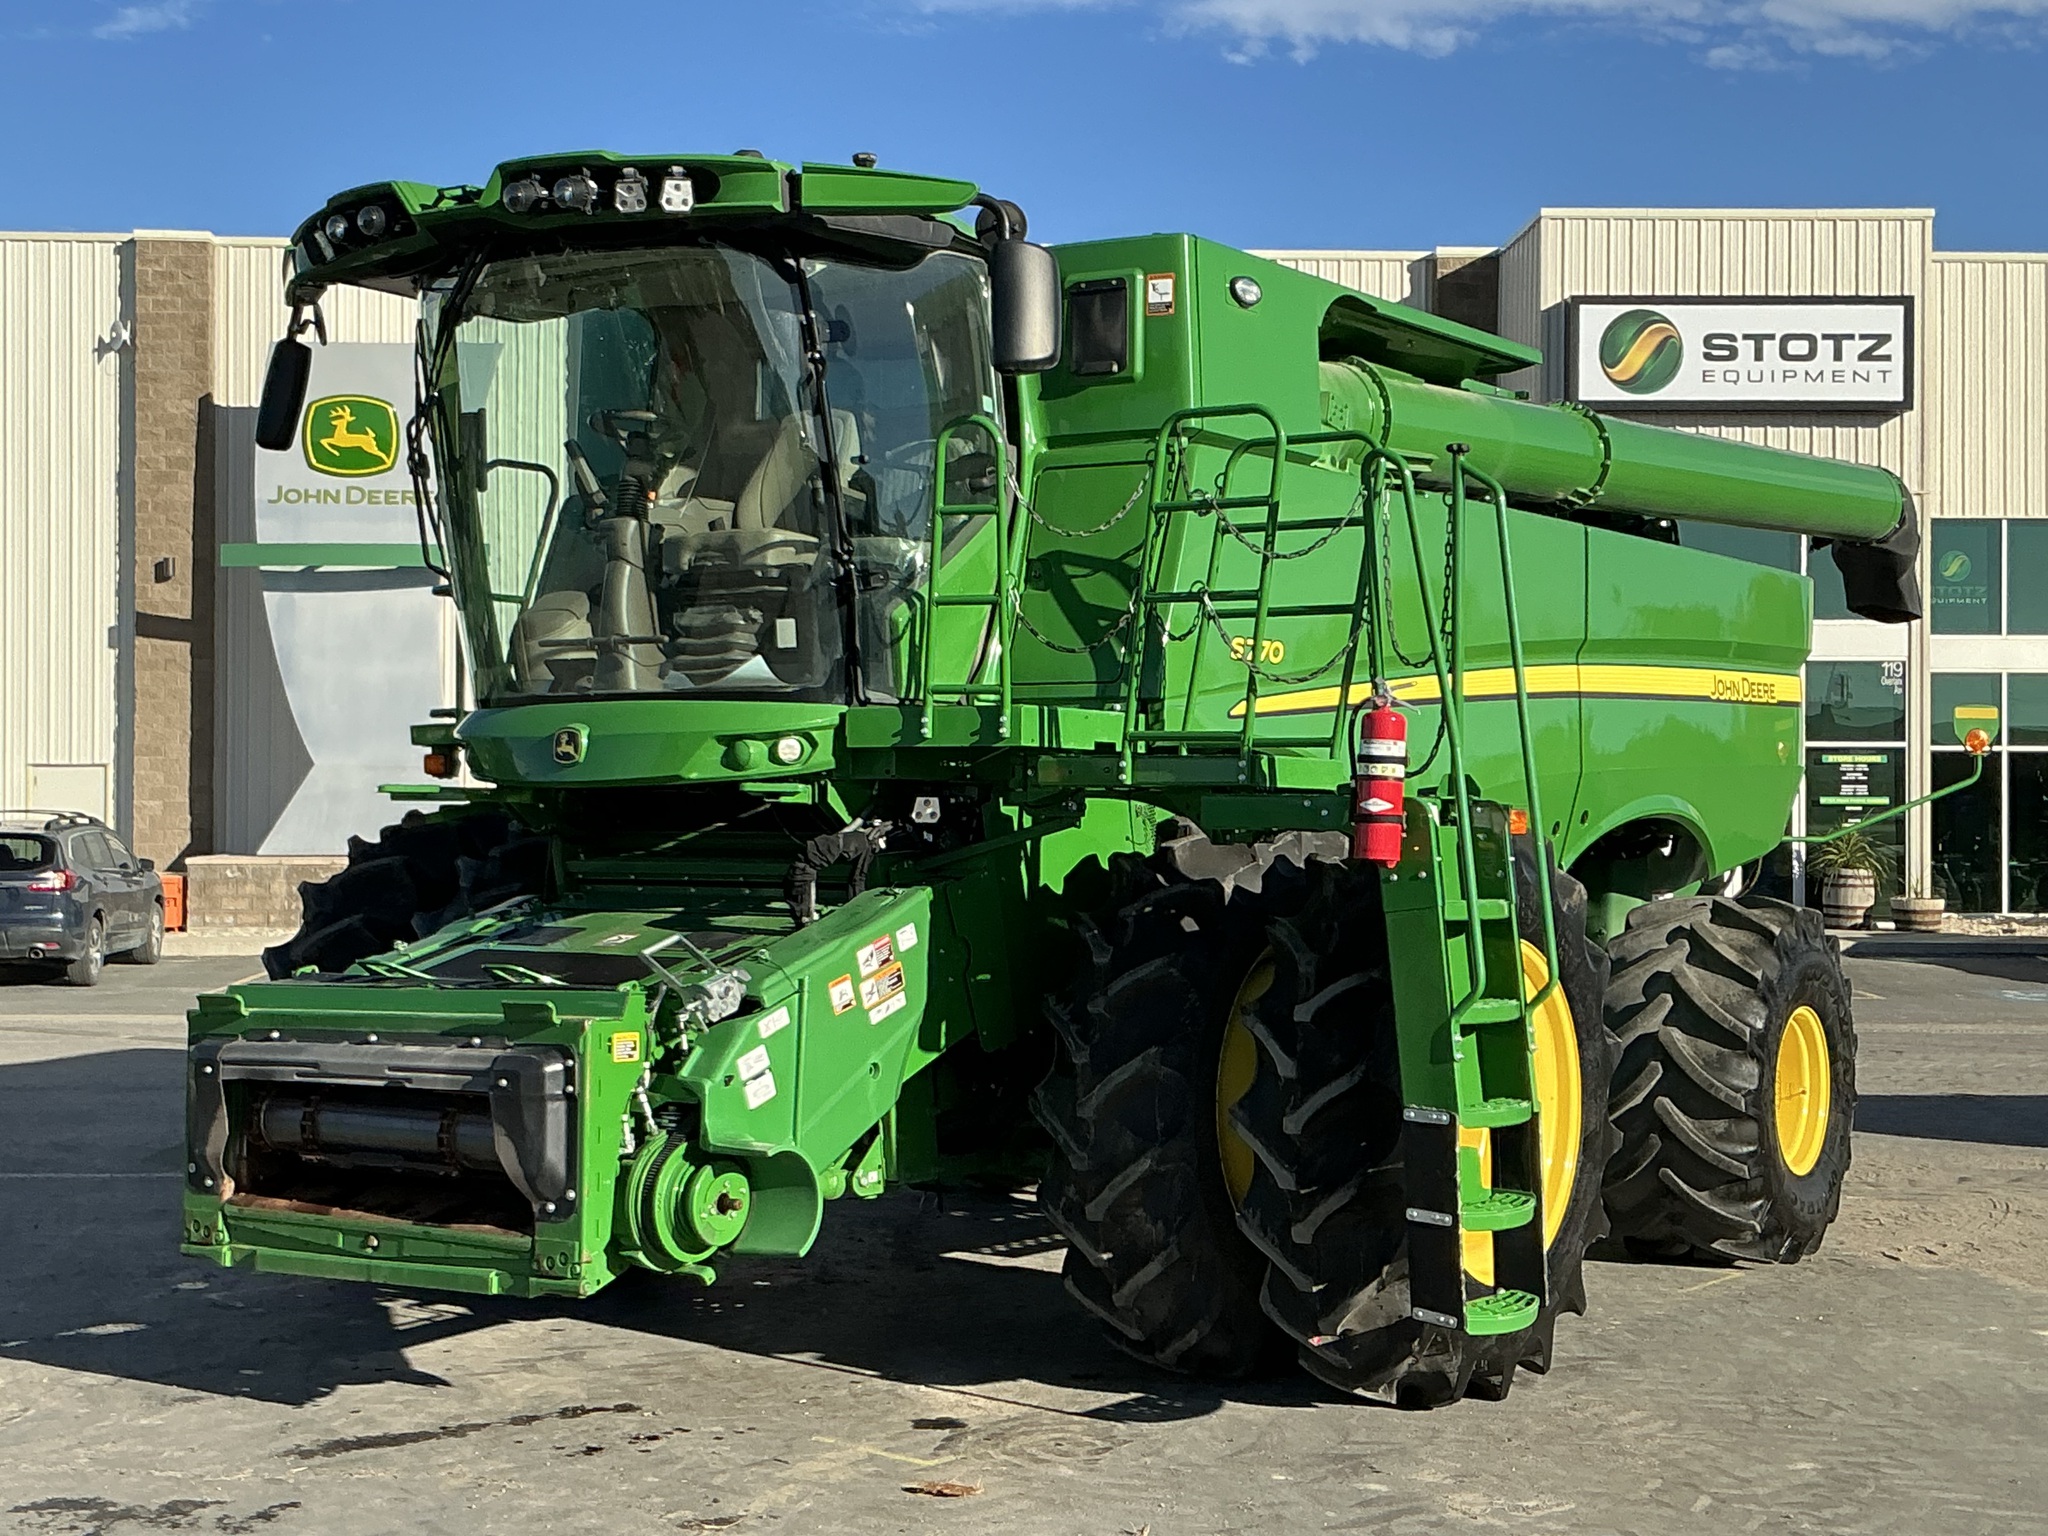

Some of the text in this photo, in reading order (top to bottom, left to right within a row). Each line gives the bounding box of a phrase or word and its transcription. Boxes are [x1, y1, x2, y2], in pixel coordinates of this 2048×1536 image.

[1703, 333, 1892, 362] STOTZ
[1702, 369, 1892, 386] EQUIPMENT
[267, 485, 342, 505] JOHN
[1932, 586, 1987, 597] TOTZ
[1881, 661, 1903, 678] 119
[1711, 674, 1777, 700] JOHN DEERE
